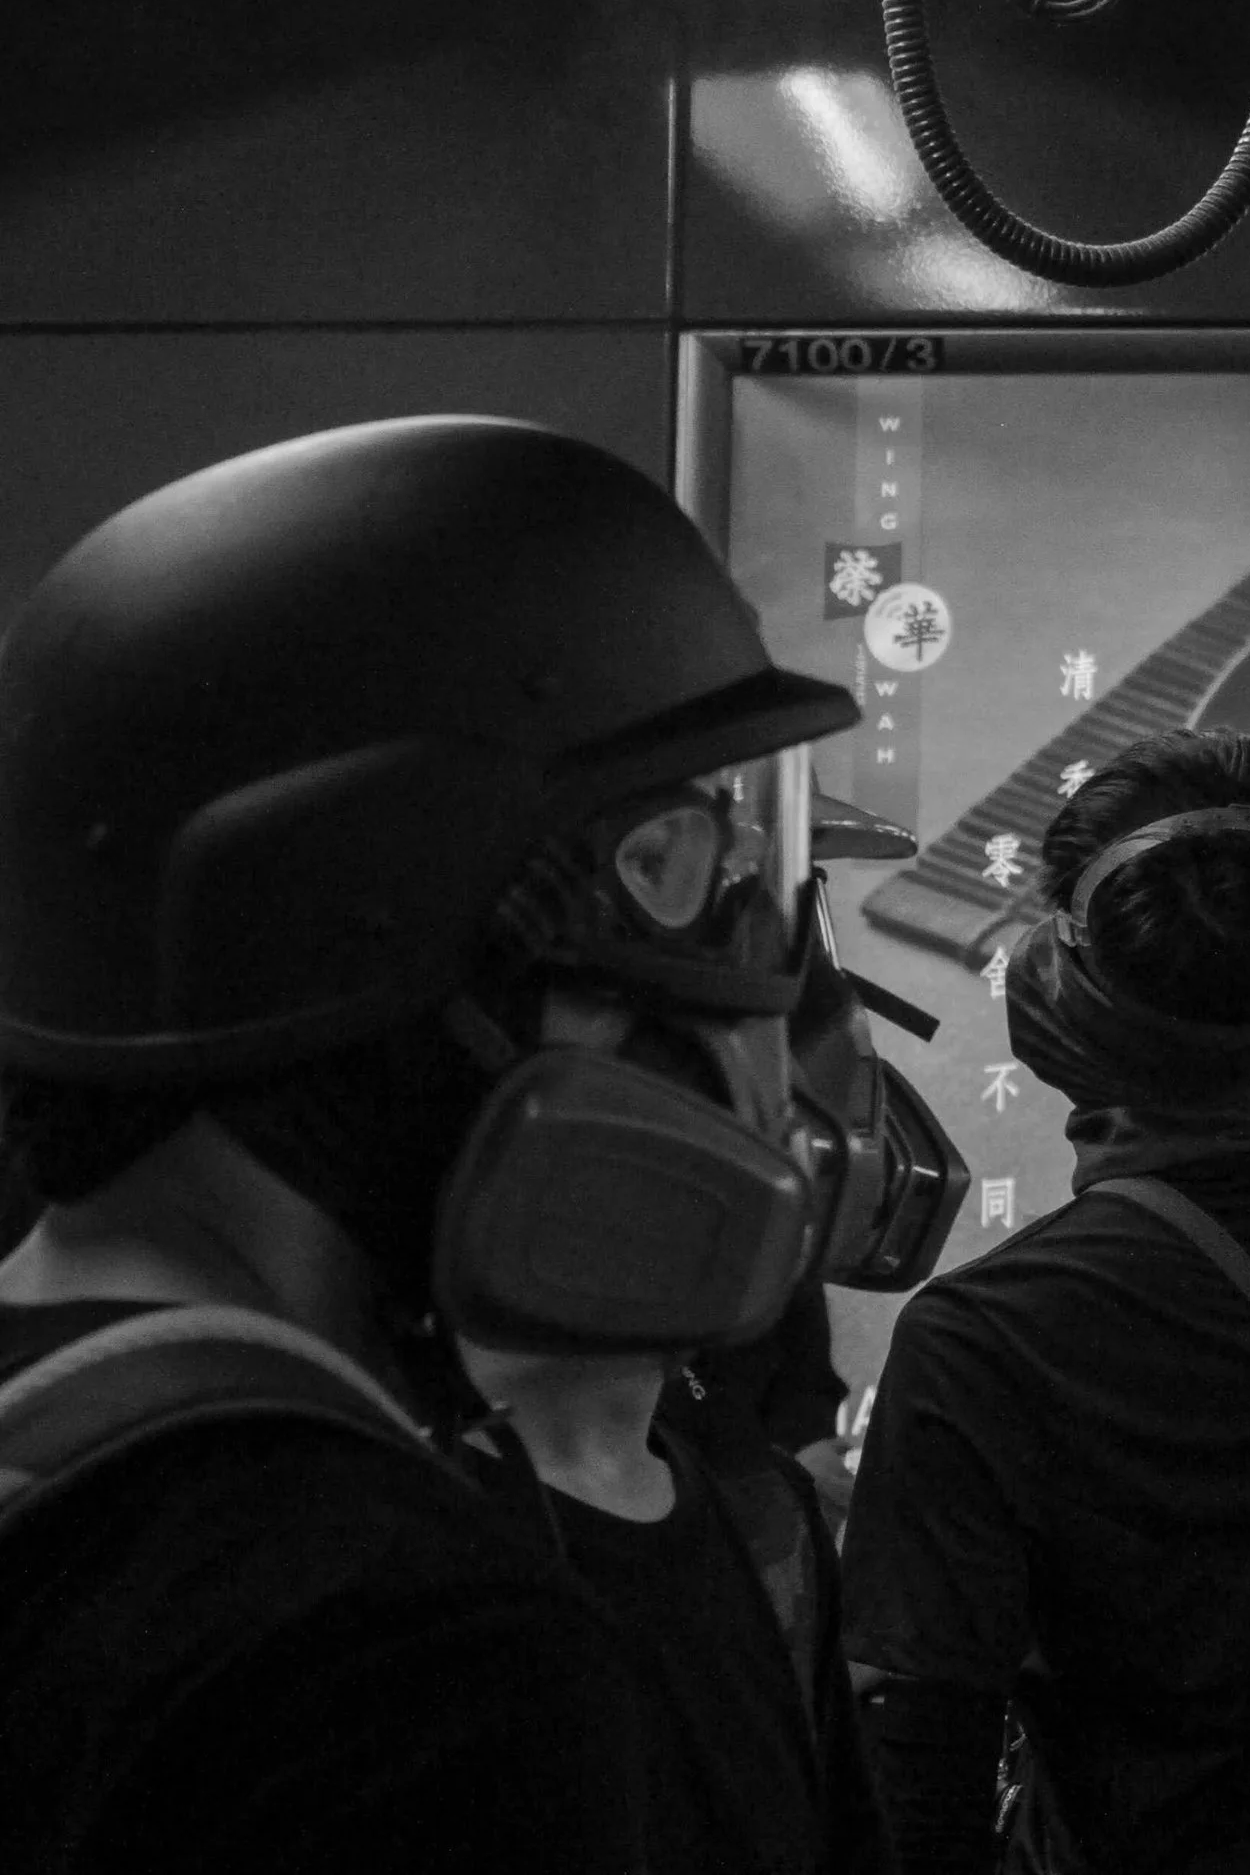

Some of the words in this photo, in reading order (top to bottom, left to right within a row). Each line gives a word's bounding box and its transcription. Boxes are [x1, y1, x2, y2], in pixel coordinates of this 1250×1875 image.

[743, 337, 937, 373] 7100/3
[878, 416, 901, 532] WING
[875, 681, 897, 765] WAH
